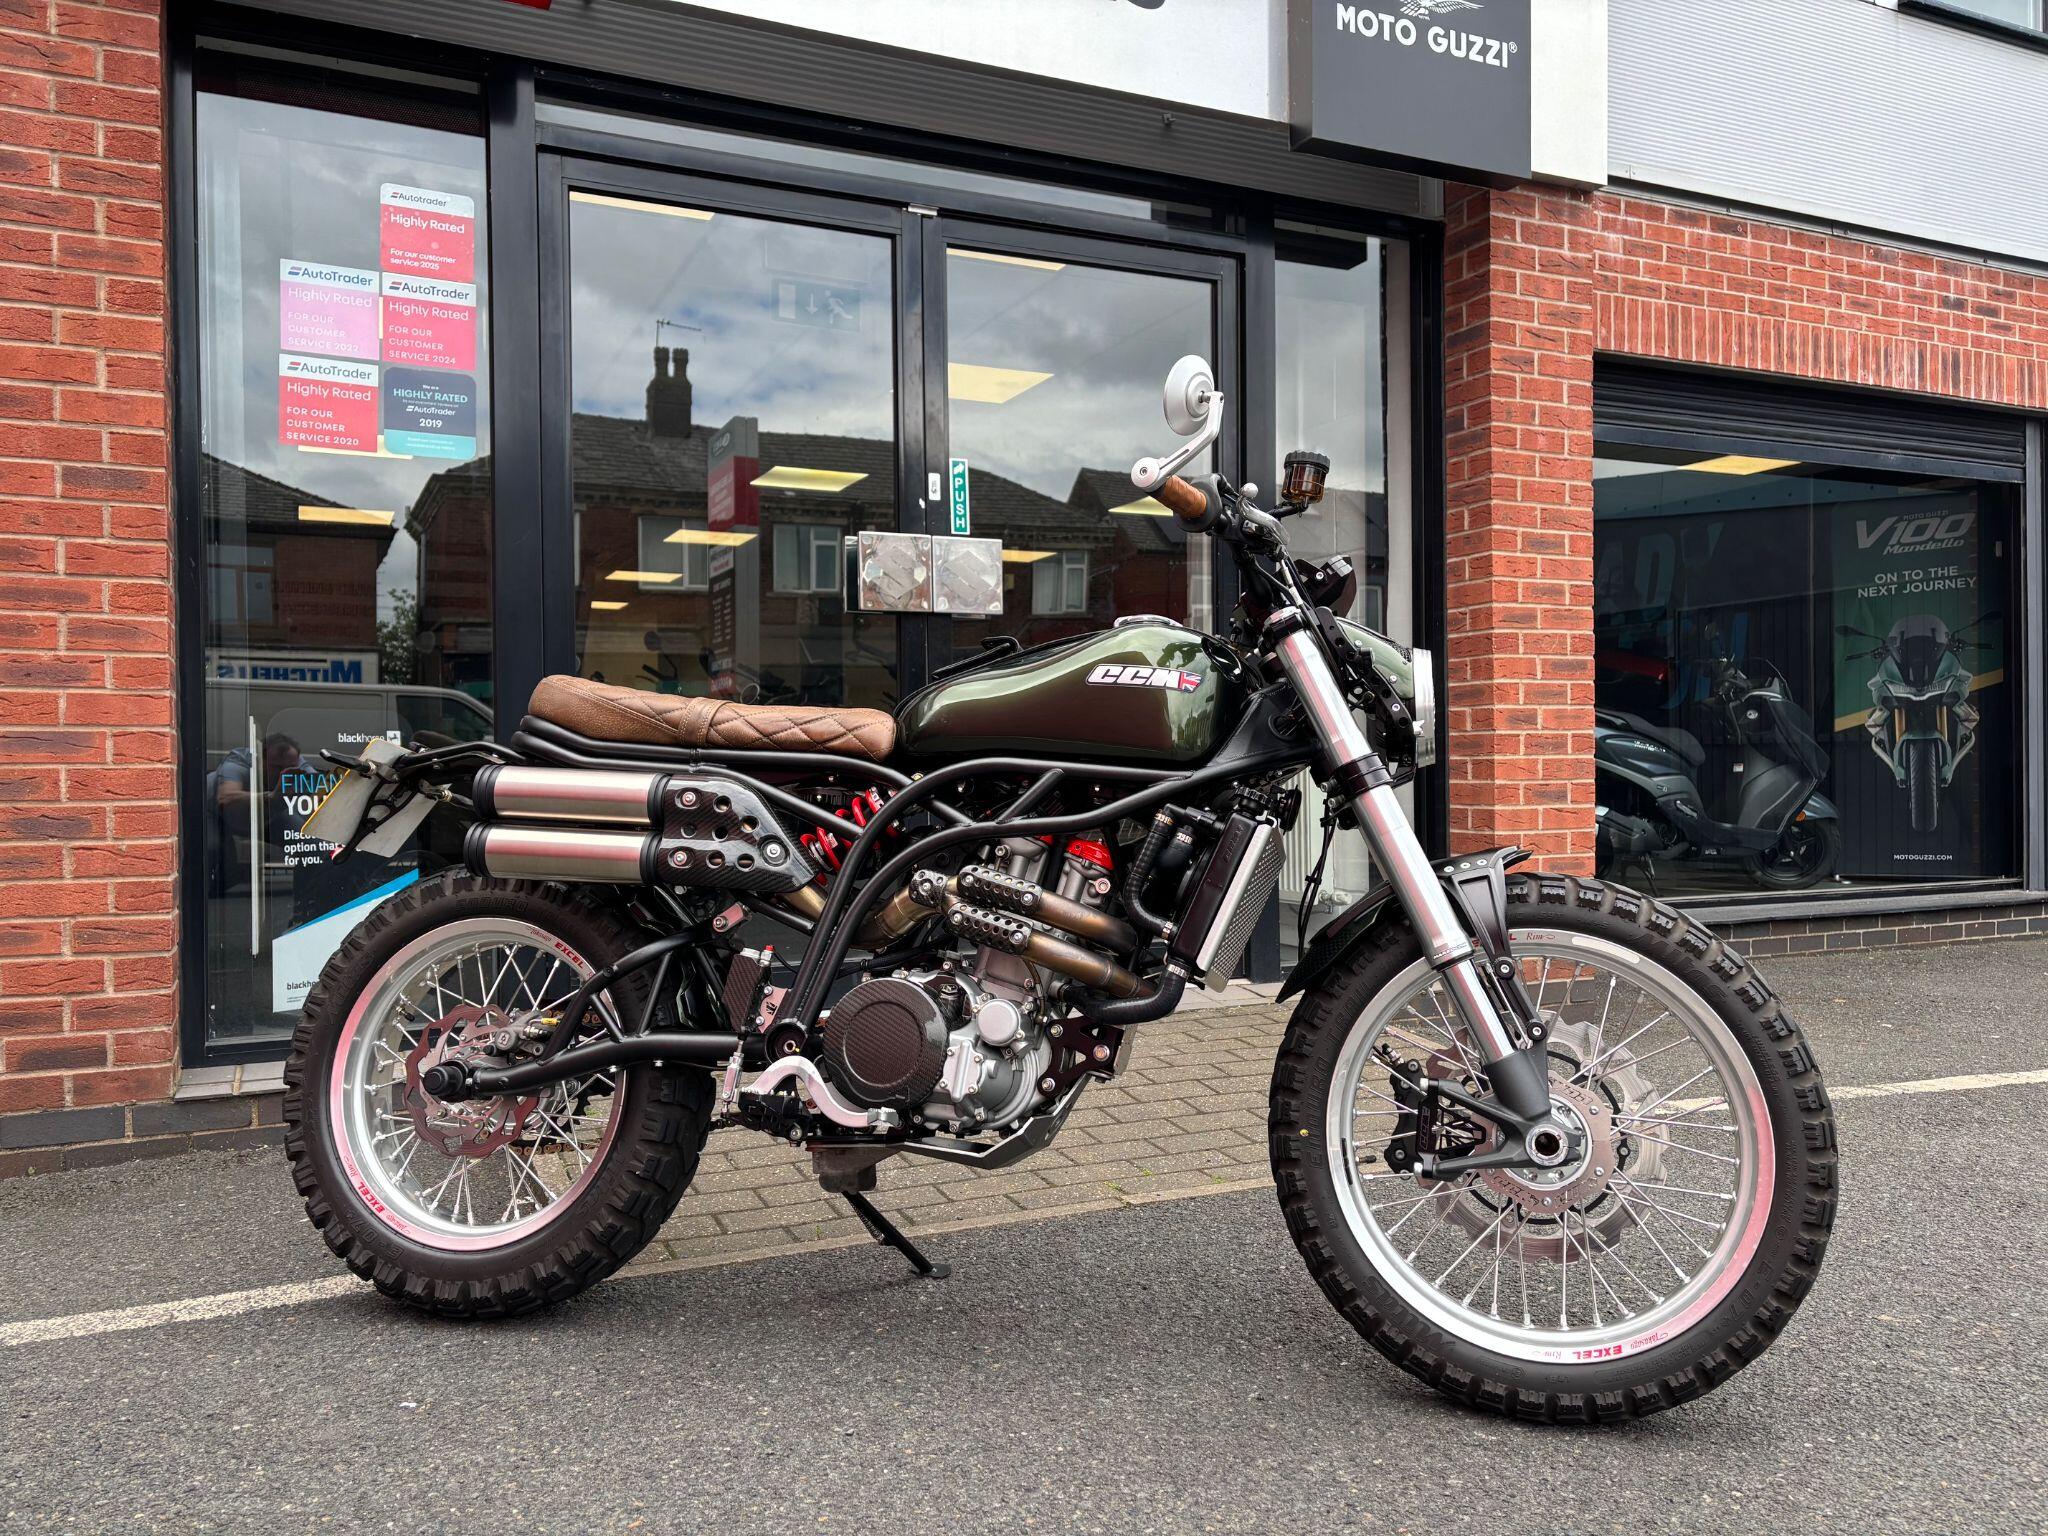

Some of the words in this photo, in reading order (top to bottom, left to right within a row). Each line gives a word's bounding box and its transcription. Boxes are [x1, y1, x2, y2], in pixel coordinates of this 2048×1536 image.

[1336, 3, 1417, 46] MOTO
[399, 192, 447, 208] Autotrader
[390, 213, 428, 229] Highly
[430, 221, 465, 234] Rated
[390, 247, 403, 256] For
[404, 251, 418, 259] our
[418, 252, 457, 264] customer
[390, 257, 420, 267] service
[420, 261, 440, 271] 2025
[302, 267, 373, 286] AutoTrader
[288, 288, 331, 304] Highly
[334, 293, 373, 308] Rated
[402, 282, 470, 300] AutoTrader
[288, 312, 309, 322] FOR
[312, 314, 335, 325] OUR
[389, 302, 429, 318] Highly
[432, 306, 469, 320] Rated
[288, 324, 346, 339] CUSTOMER
[389, 325, 409, 335] FOR
[411, 328, 432, 337] OUR
[288, 337, 332, 349] SERVICE
[389, 338, 444, 350] CUSTOMER
[389, 350, 430, 362] SERVICE
[432, 355, 457, 365] 2024
[301, 362, 373, 380] AutoTrader
[287, 382, 330, 398] Highly
[332, 387, 371, 401] Rated
[393, 388, 432, 400] HIGHLY
[434, 393, 468, 403] RATED
[286, 406, 308, 416] FOR
[311, 409, 333, 418] OUR
[413, 406, 456, 416] AutoTrader
[286, 419, 346, 432] CUSTOMER
[419, 418, 443, 428] 2019
[286, 431, 331, 443] SERVICE
[333, 436, 359, 446] 2020
[954, 477, 966, 529] PUSH
[1903, 513, 1924, 521] MOTO
[1925, 509, 1949, 519] GUZZI
[1856, 512, 1976, 549] V100
[1883, 538, 1965, 556] Mandello
[1874, 572, 1898, 584] ON
[1903, 569, 1923, 581] TO
[1928, 565, 1959, 578] THE
[1857, 584, 1898, 599] NEXT
[1902, 576, 1977, 594] JOURNEY
[1087, 664, 1181, 689] CCM
[281, 774, 343, 794] FINAN
[284, 843, 317, 855] option
[284, 856, 300, 866] for
[301, 856, 323, 867] you.
[554, 941, 584, 969] EXCEL
[286, 980, 316, 990] blackho
[357, 1182, 385, 1213] EXCEL
[1572, 1344, 1624, 1360] EXCEL
